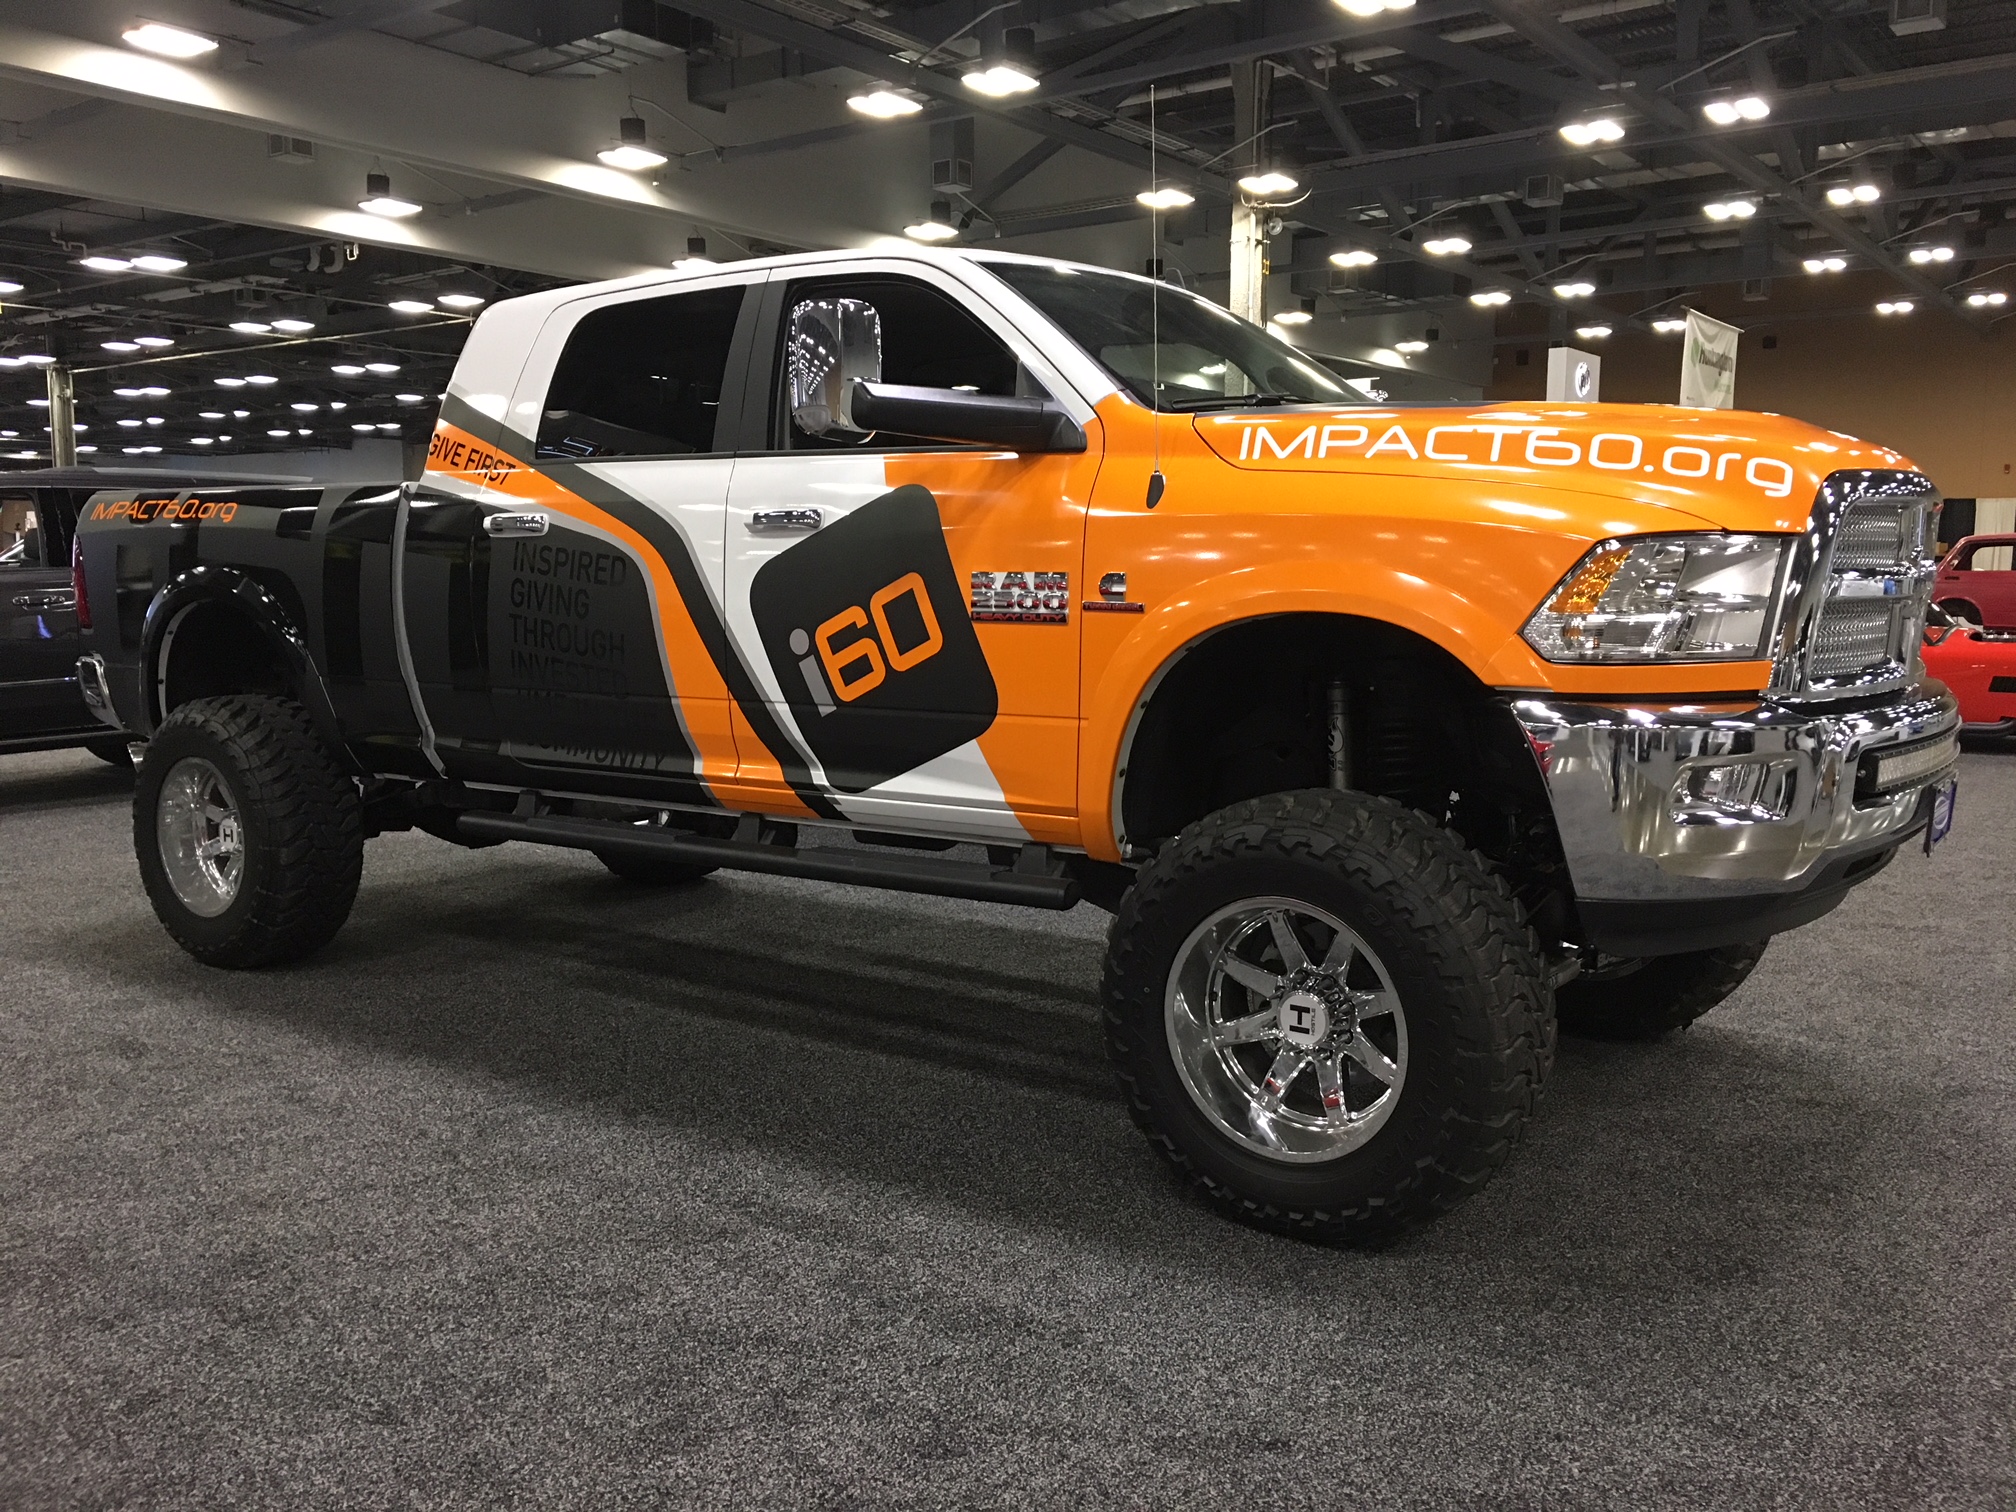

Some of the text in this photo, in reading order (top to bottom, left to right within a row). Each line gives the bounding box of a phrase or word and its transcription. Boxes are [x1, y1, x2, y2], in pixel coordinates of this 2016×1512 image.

[429, 433, 516, 485] GIVE FIRST
[1239, 424, 1794, 497] IMPACT60.org
[90, 499, 238, 523] IMPACT60.org
[512, 541, 628, 587] INSPIRED
[971, 572, 1069, 590] RAM
[510, 578, 590, 619] GIVING
[973, 613, 1064, 621] HEAVY DUTY
[508, 613, 626, 664] THROUGH
[789, 572, 943, 717] i60
